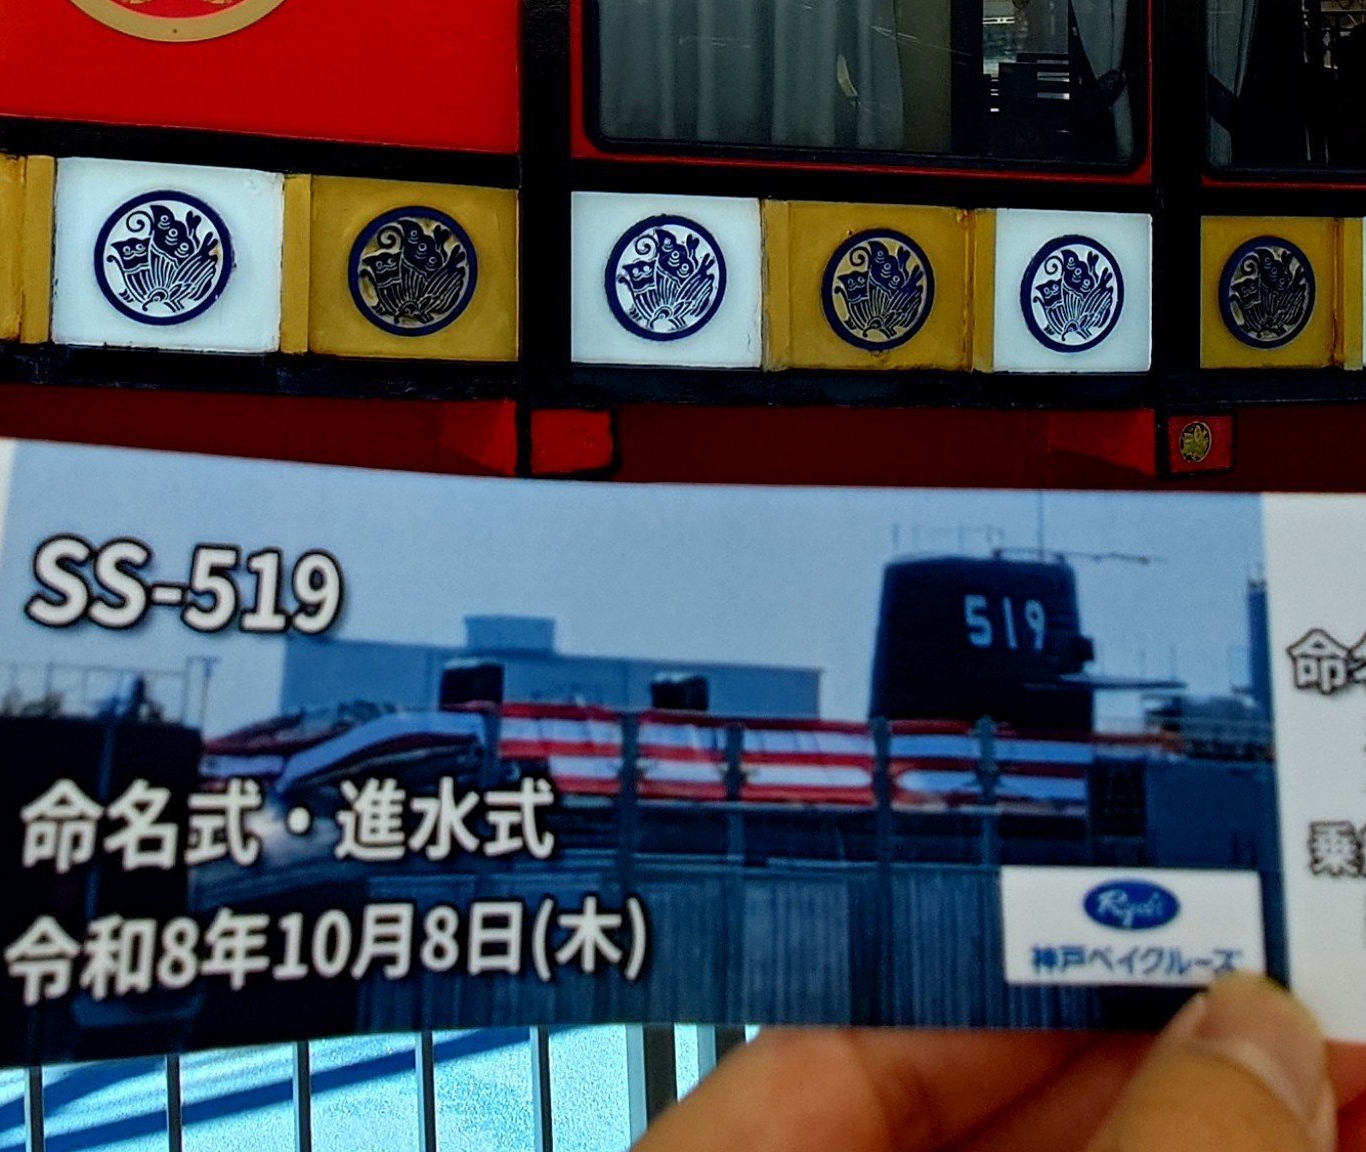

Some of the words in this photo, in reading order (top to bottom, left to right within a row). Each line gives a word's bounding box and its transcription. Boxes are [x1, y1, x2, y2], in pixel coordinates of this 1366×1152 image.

[26, 535, 343, 633] SS-519
[963, 593, 1046, 651] 519
[5, 896, 647, 1005] 令和8年10月8日(木)
